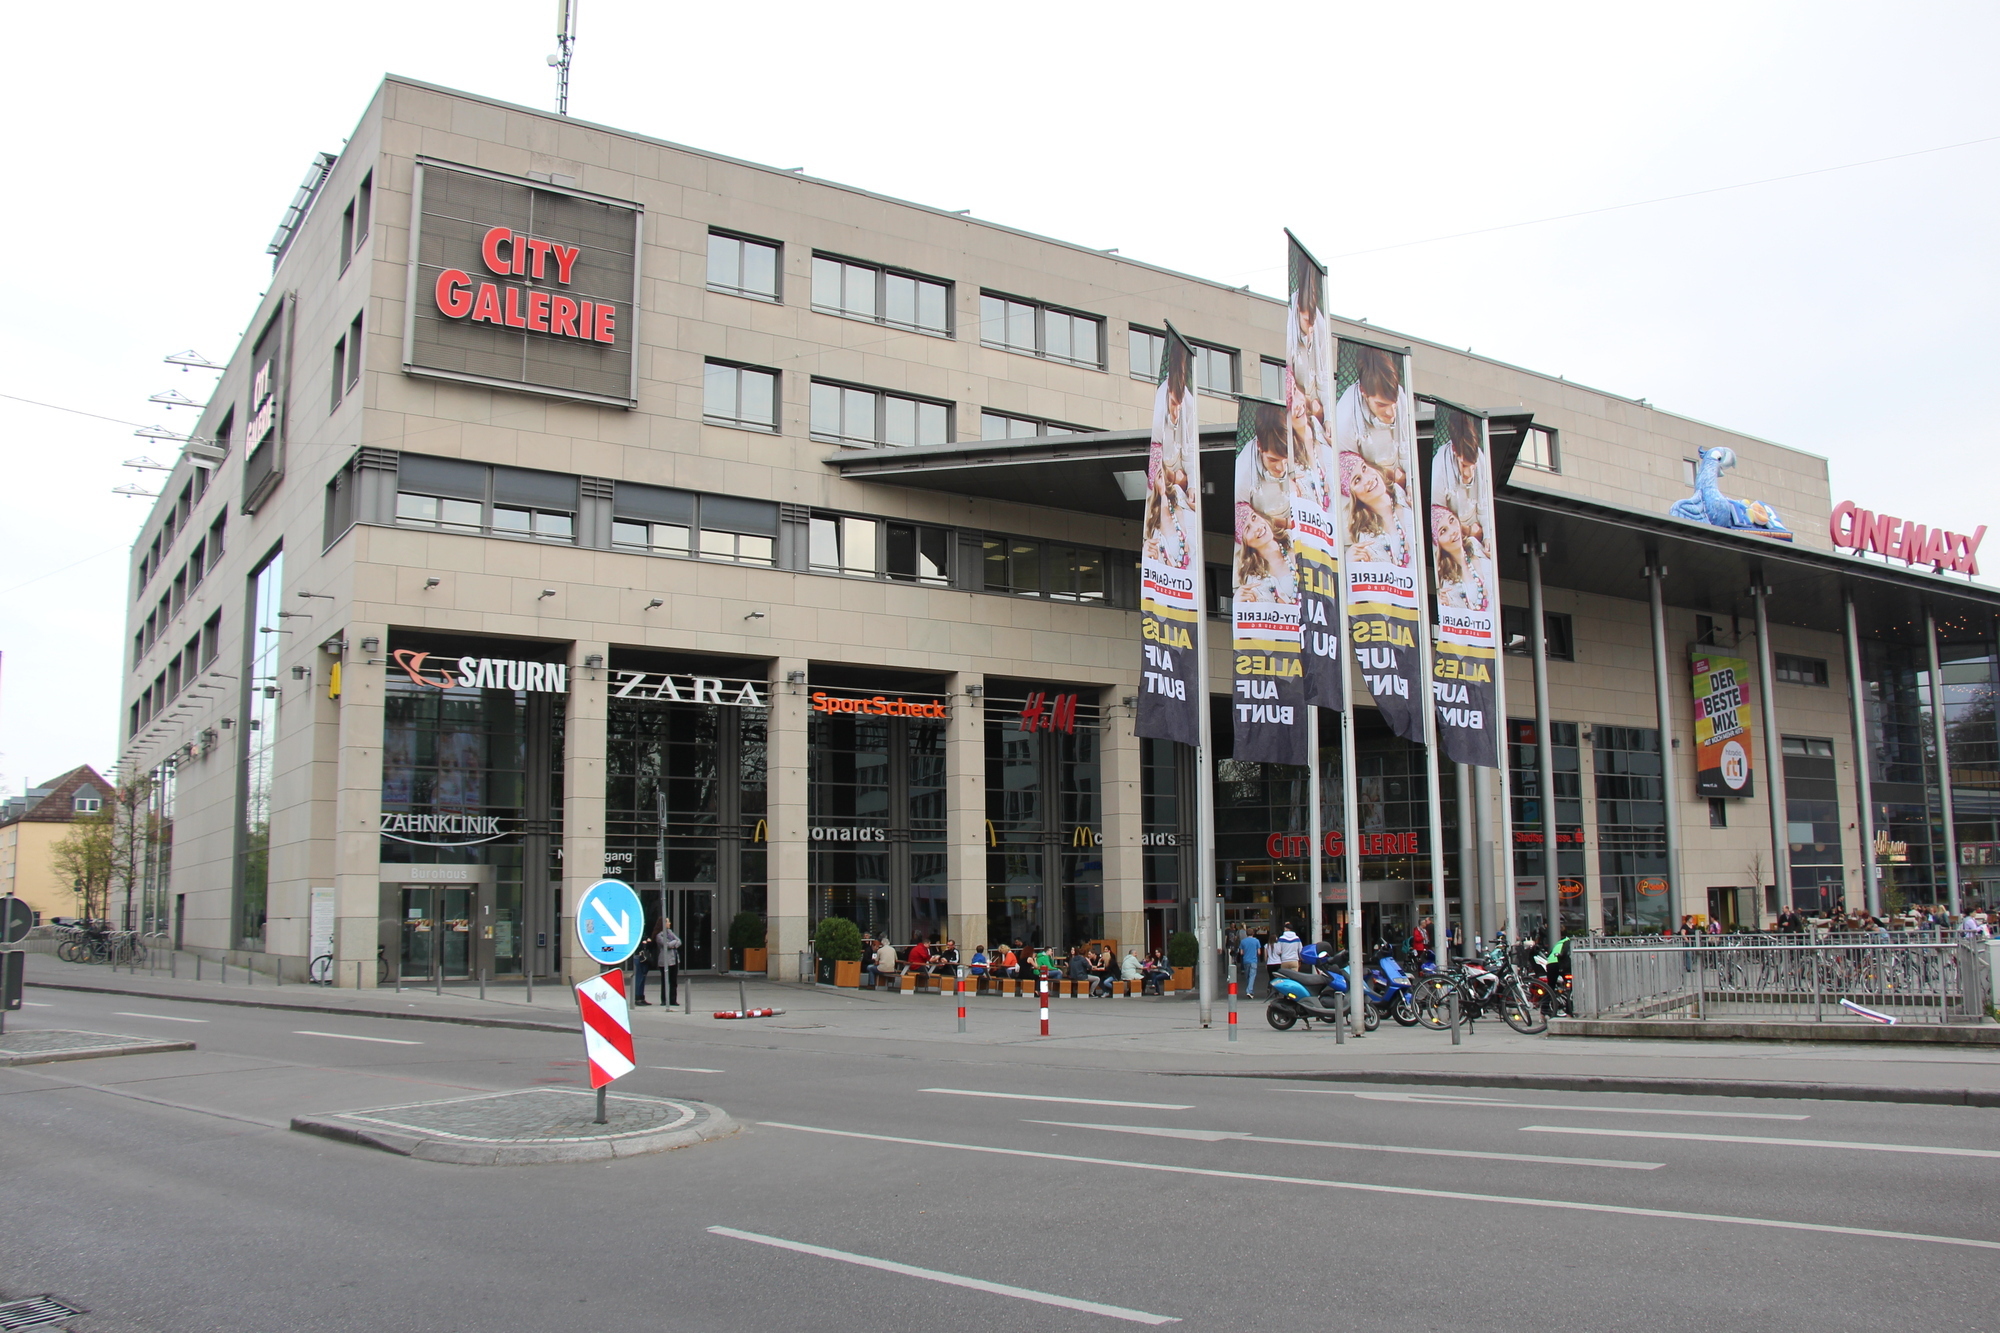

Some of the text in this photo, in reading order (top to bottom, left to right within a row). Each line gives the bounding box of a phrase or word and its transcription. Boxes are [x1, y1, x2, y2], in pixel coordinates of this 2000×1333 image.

[482, 226, 581, 285] CITY
[435, 268, 616, 344] GALERIE
[1830, 500, 1988, 576] CINEMAXX
[457, 656, 566, 693] SATURN
[614, 671, 767, 708] ZARA
[1709, 668, 1736, 693] DER
[812, 691, 947, 718] SportScheck
[1019, 691, 1078, 735] H&M
[1702, 687, 1742, 716] BESTE
[1711, 709, 1739, 735] MIX!
[380, 812, 500, 834] ZAHNKLINIK
[484, 905, 490, 915] 1
